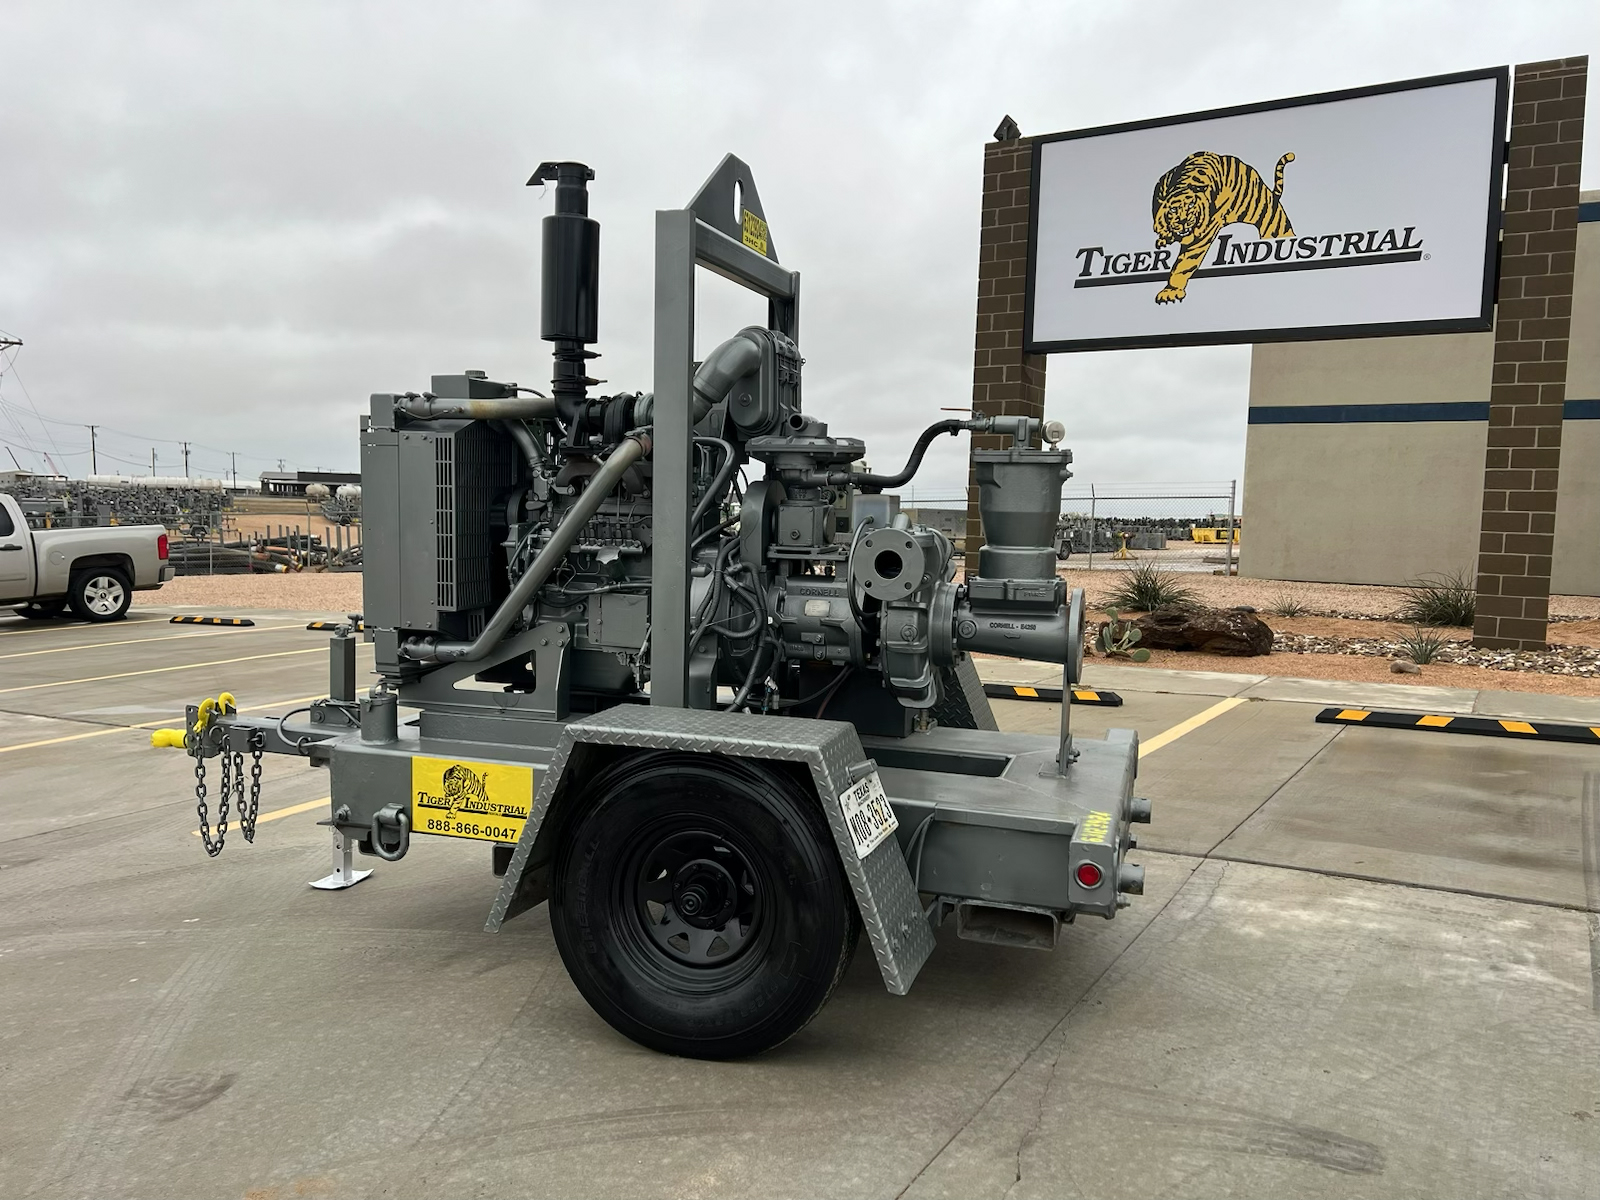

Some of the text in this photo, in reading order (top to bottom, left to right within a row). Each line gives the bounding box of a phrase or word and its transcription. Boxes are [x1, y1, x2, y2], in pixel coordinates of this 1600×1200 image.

[1075, 226, 1424, 278] TIGER INDUSTRIAL
[800, 588, 840, 597] CORNELL
[853, 782, 869, 800] TEXAS
[417, 791, 528, 816] TIGER INDUSTRIAL
[427, 818, 517, 840] 888-866-0047
